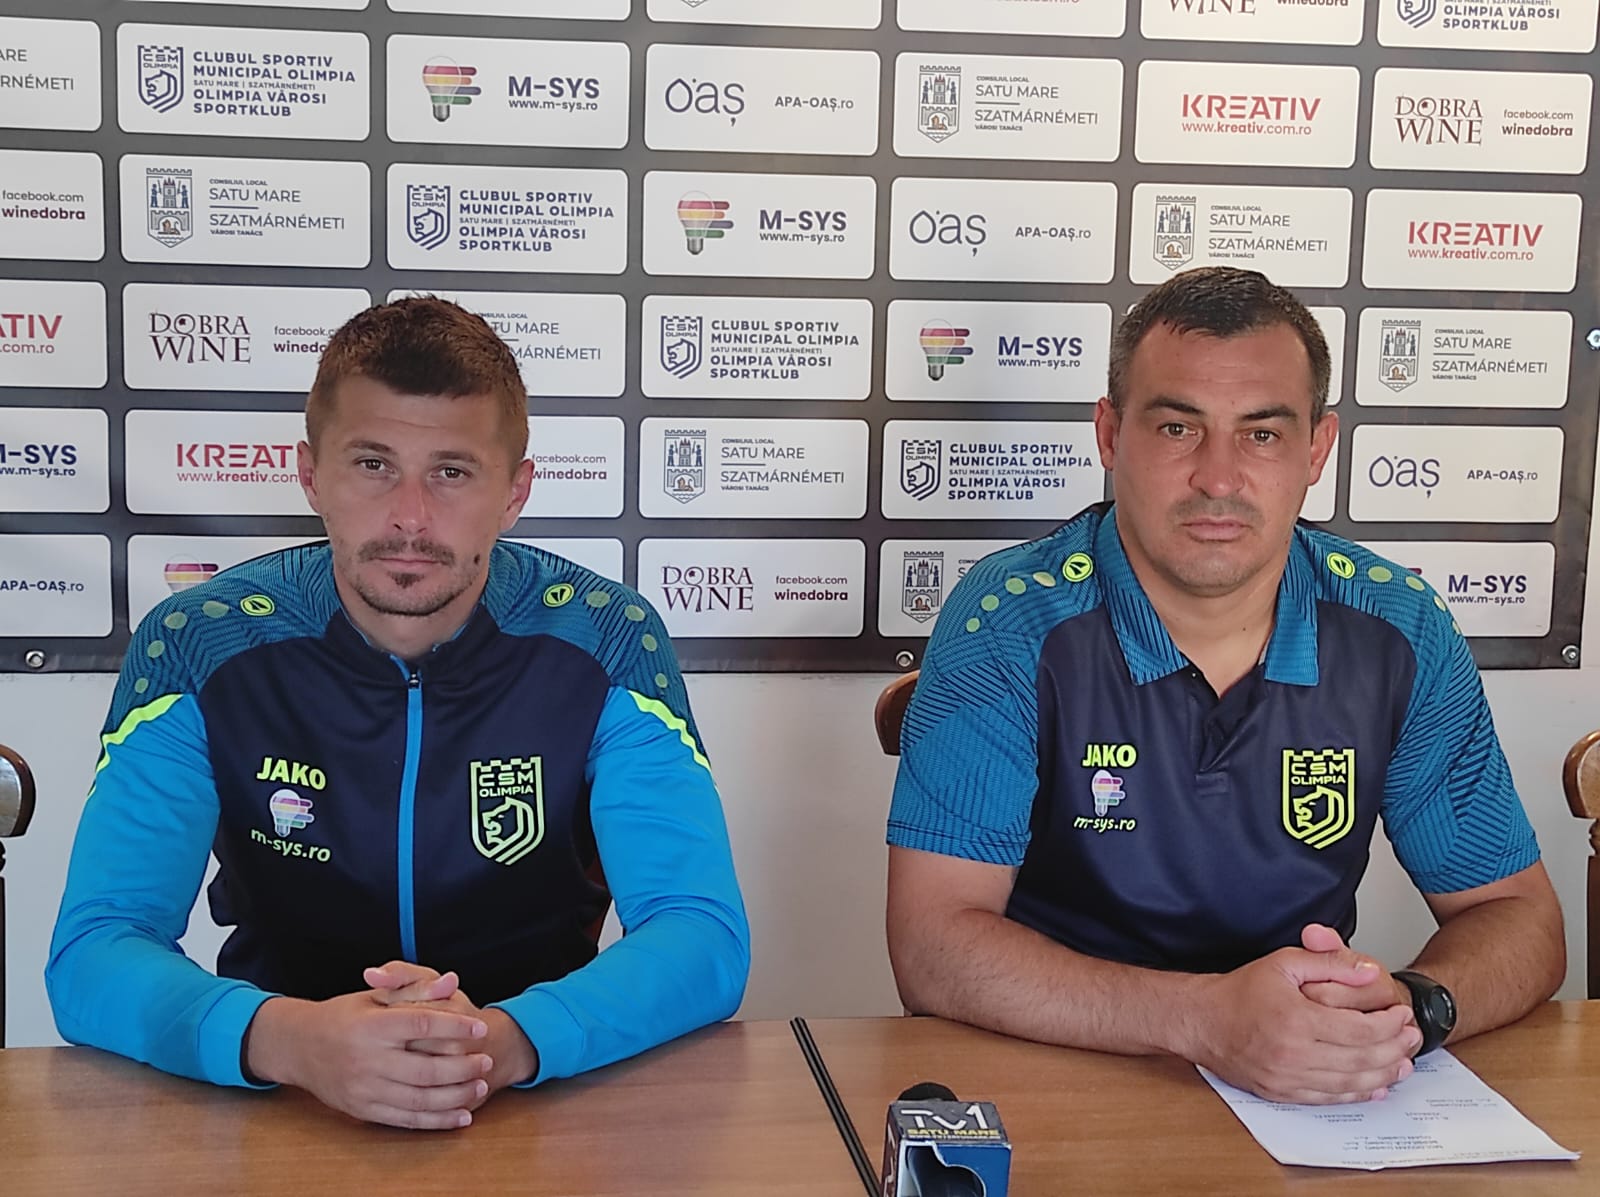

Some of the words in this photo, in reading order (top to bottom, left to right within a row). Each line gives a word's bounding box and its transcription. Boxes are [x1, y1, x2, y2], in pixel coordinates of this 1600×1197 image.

[1444, 5, 1503, 17] OLIMPIA
[1508, 5, 1560, 19] VÁROSI
[1443, 18, 1528, 30] SPORTKLUB
[193, 51, 257, 64] CLUBUL
[262, 54, 332, 67] SPORTIV
[193, 65, 282, 79] MUNICIPAL
[287, 69, 355, 82] OLIMPIA
[508, 76, 600, 99] M-SYS
[975, 84, 1013, 97] SATU
[1017, 85, 1059, 98] MARE
[193, 88, 261, 101] OLIMPIA
[266, 89, 326, 104] VÁROSI
[193, 102, 291, 116] SPORTKLUB
[508, 99, 598, 112] www.m-sys.ro
[1182, 94, 1321, 121] KREATIV
[1395, 96, 1482, 119] DOBRA
[974, 106, 1098, 124] SZATMÁRNÉMETI
[1503, 109, 1574, 121] facebook.com
[1182, 122, 1312, 136] www.kreativ.com.ro
[1395, 118, 1482, 146] WINE
[1502, 124, 1573, 137] winedobra
[2, 190, 84, 203] facebook.com
[209, 187, 249, 201] SATU
[254, 188, 300, 202] MARE
[459, 190, 520, 201] CLUBUL
[526, 191, 593, 203] SPORTIV
[2, 206, 86, 220] winedobra
[459, 203, 544, 216] MUNICIPAL
[549, 206, 614, 217] OLIMPIA
[209, 210, 344, 229] SZATMÁRNÉMETI
[760, 210, 847, 231] M-SYS
[1209, 213, 1245, 226] SATU
[1249, 214, 1290, 227] MARE
[459, 226, 524, 238] OLIMPIA
[528, 226, 585, 239] VÁROSI
[760, 232, 846, 245] www.m-sys.ro
[1408, 221, 1544, 247] KREATIV
[458, 239, 551, 252] SPORTKLUB
[1208, 235, 1328, 252] SZATMÁRNÉMETI
[1408, 248, 1534, 261] www.kreativ.com.ro
[150, 312, 251, 335] DOBRA
[516, 322, 560, 335] MARE
[711, 320, 770, 331] CLUBUL
[775, 321, 839, 332] SPORTIV
[274, 326, 335, 336] facebook.c
[711, 333, 792, 344] MUNICIPAL
[797, 335, 859, 345] OLIMPIA
[1433, 336, 1469, 348] SATU
[1472, 337, 1512, 349] MARE
[150, 334, 251, 364] WINE
[510, 345, 600, 360] MÁRNÉMETI
[998, 336, 1083, 357] M-SYS
[711, 355, 773, 366] OLIMPIA
[777, 354, 831, 366] VÁROSI
[998, 357, 1081, 370] www.m-sys.ro
[1432, 357, 1548, 373] SZATMÁRNÉMETI
[710, 368, 799, 379] SPORTKLUB
[177, 444, 294, 468] KREAT
[720, 447, 757, 459] SATU
[762, 447, 804, 459] MARE
[950, 444, 1006, 453] CLUBUL
[1011, 444, 1074, 454] SPORTIV
[949, 456, 1028, 466] MUNICIPAL
[1032, 457, 1093, 467] OLIMPIA
[720, 469, 844, 483] SZATMÁRNÉMETI
[948, 477, 1009, 487] OLIMPIA
[1013, 476, 1066, 487] VÁROSI
[947, 489, 1034, 500] SPORTKLUB
[661, 564, 754, 586] DOBRA
[775, 575, 848, 585] facebook.com
[1448, 575, 1527, 594] M-SYS
[662, 586, 754, 612] WINE
[774, 589, 848, 601] winedobra
[1448, 594, 1525, 606] www.m-sys.ro
[1082, 744, 1137, 768] JAKO
[256, 757, 327, 791] JAKO
[1291, 761, 1346, 775] CSM
[478, 769, 534, 787] CSM
[1291, 775, 1346, 785] OLIMPIA
[478, 785, 534, 798] OLIMPIA
[1074, 815, 1136, 833] m-sys.ro
[250, 828, 331, 862] m-sys.ro
[907, 1128, 949, 1136] SATU
